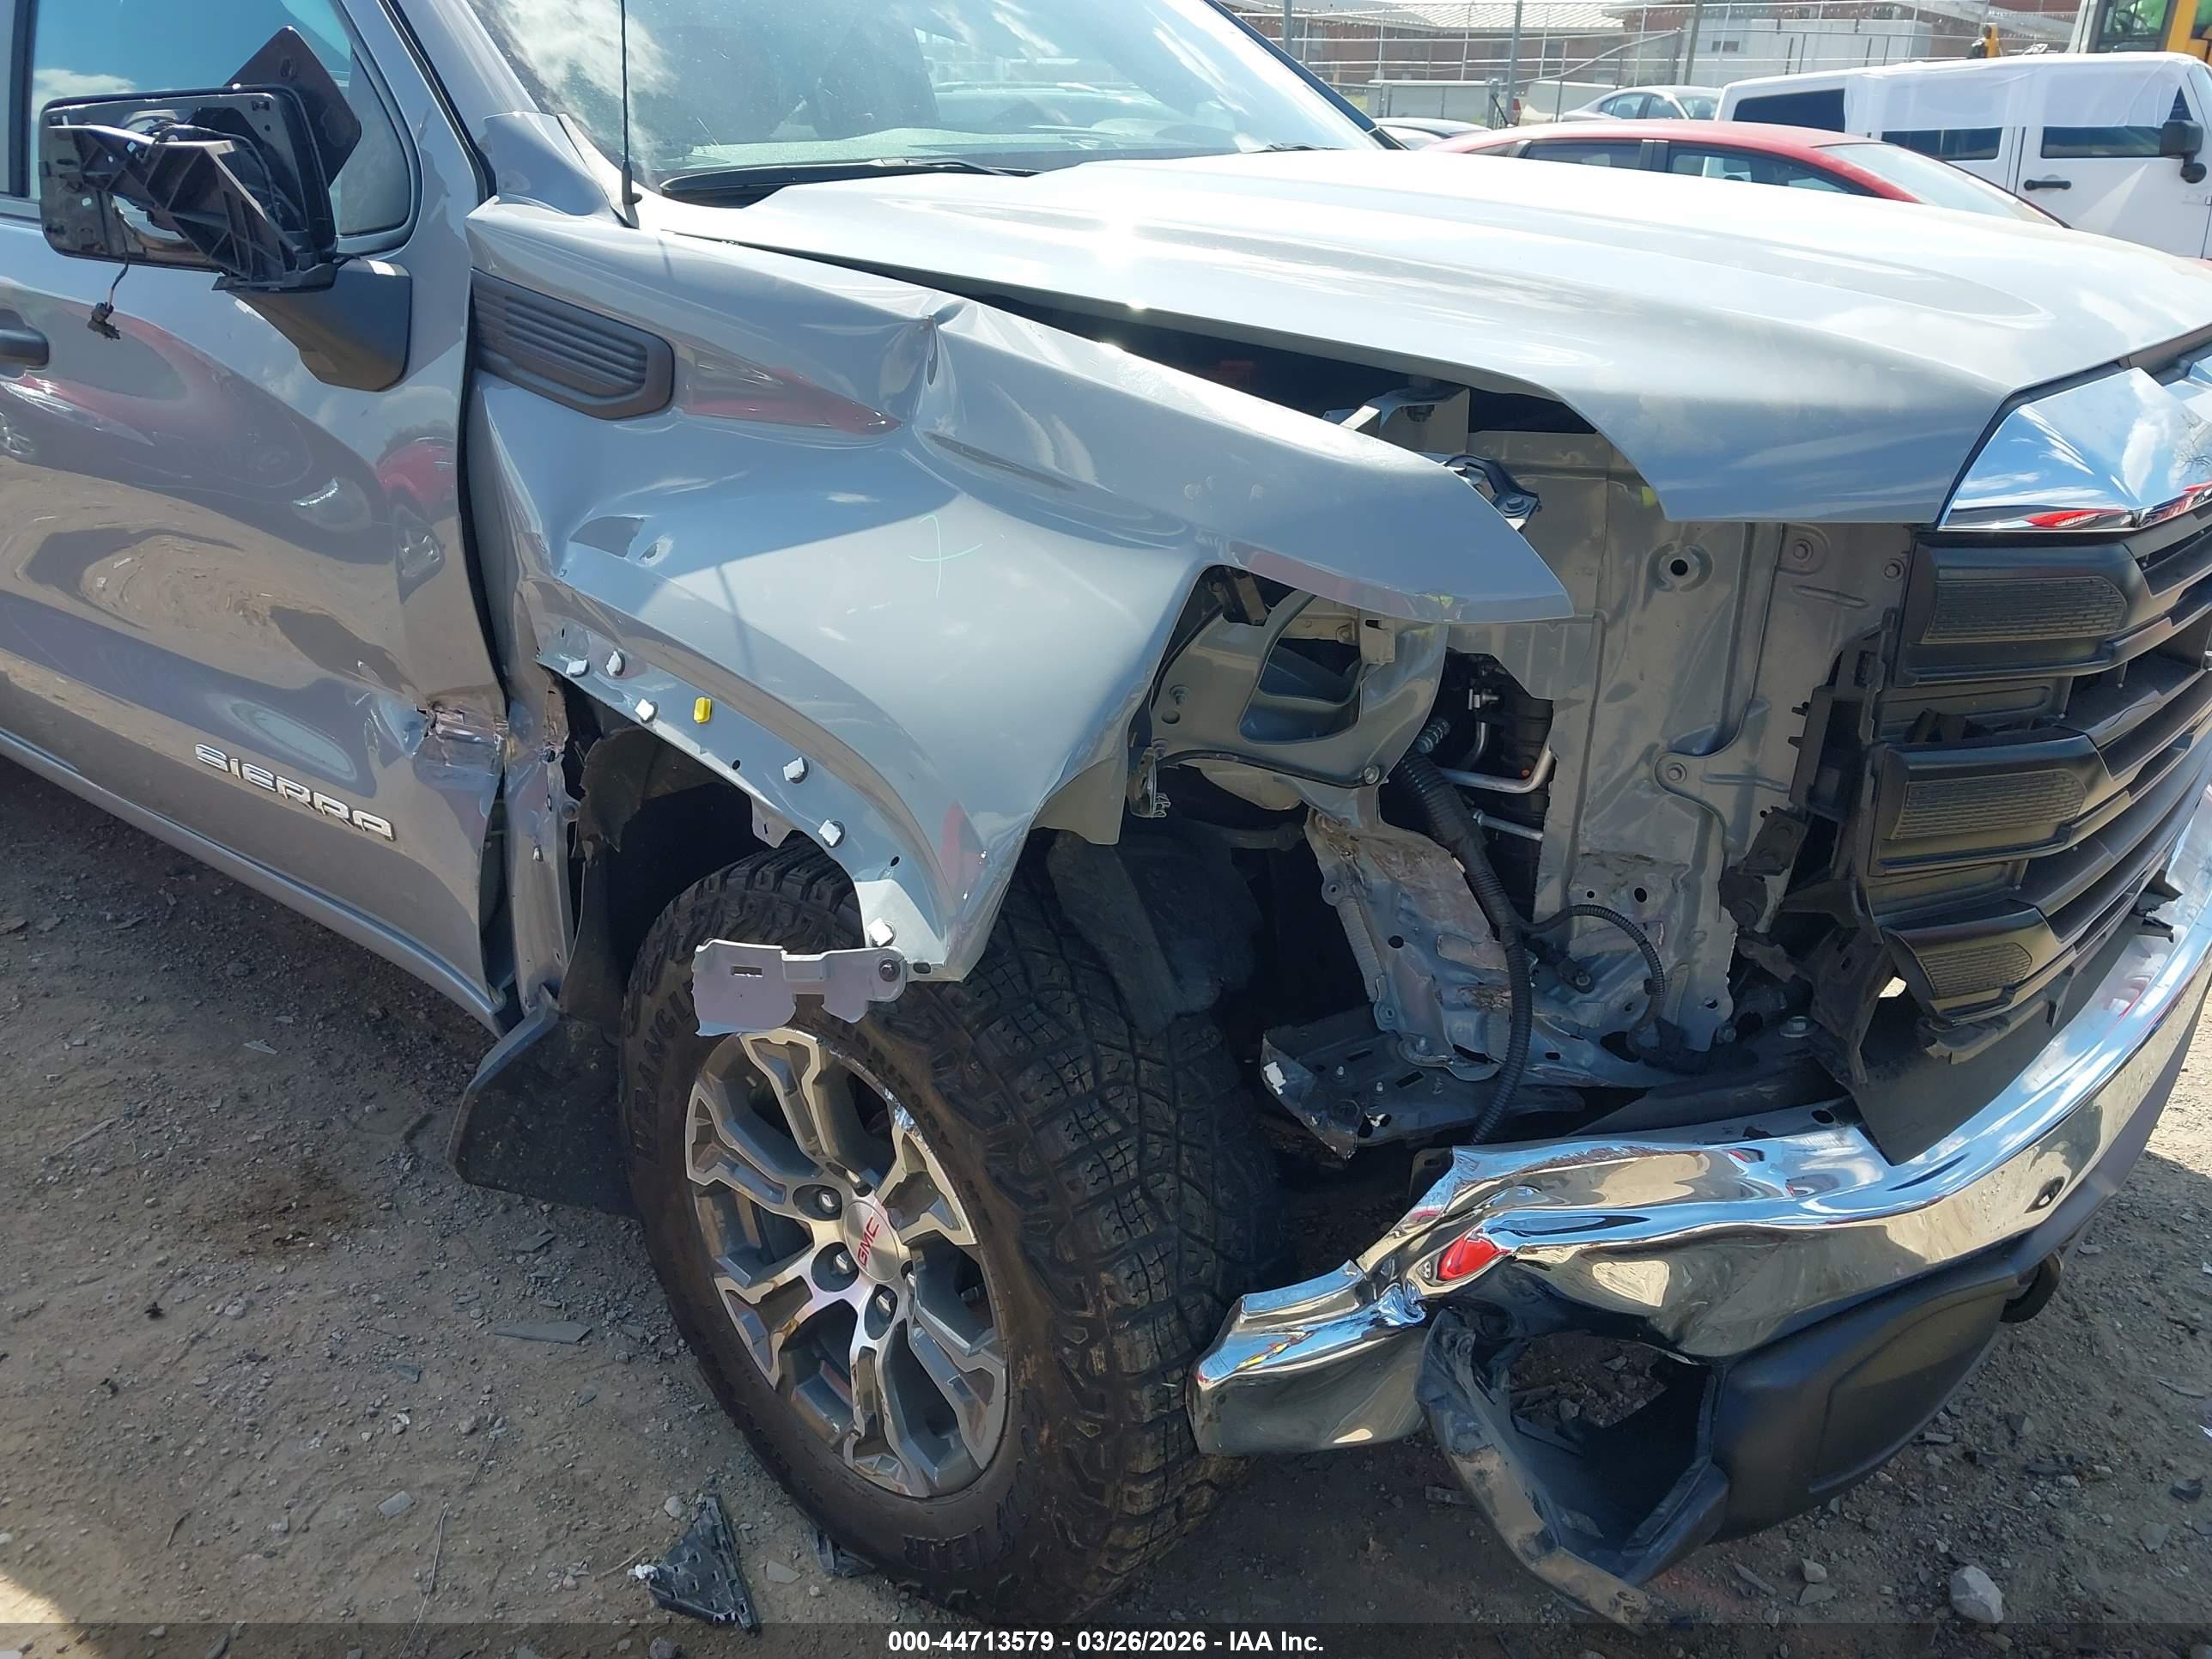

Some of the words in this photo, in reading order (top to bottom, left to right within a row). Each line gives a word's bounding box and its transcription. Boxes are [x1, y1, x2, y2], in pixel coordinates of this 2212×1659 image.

[195, 743, 395, 842] SIERRA
[631, 979, 695, 1165] WRANGL
[858, 1216, 880, 1267] GMC
